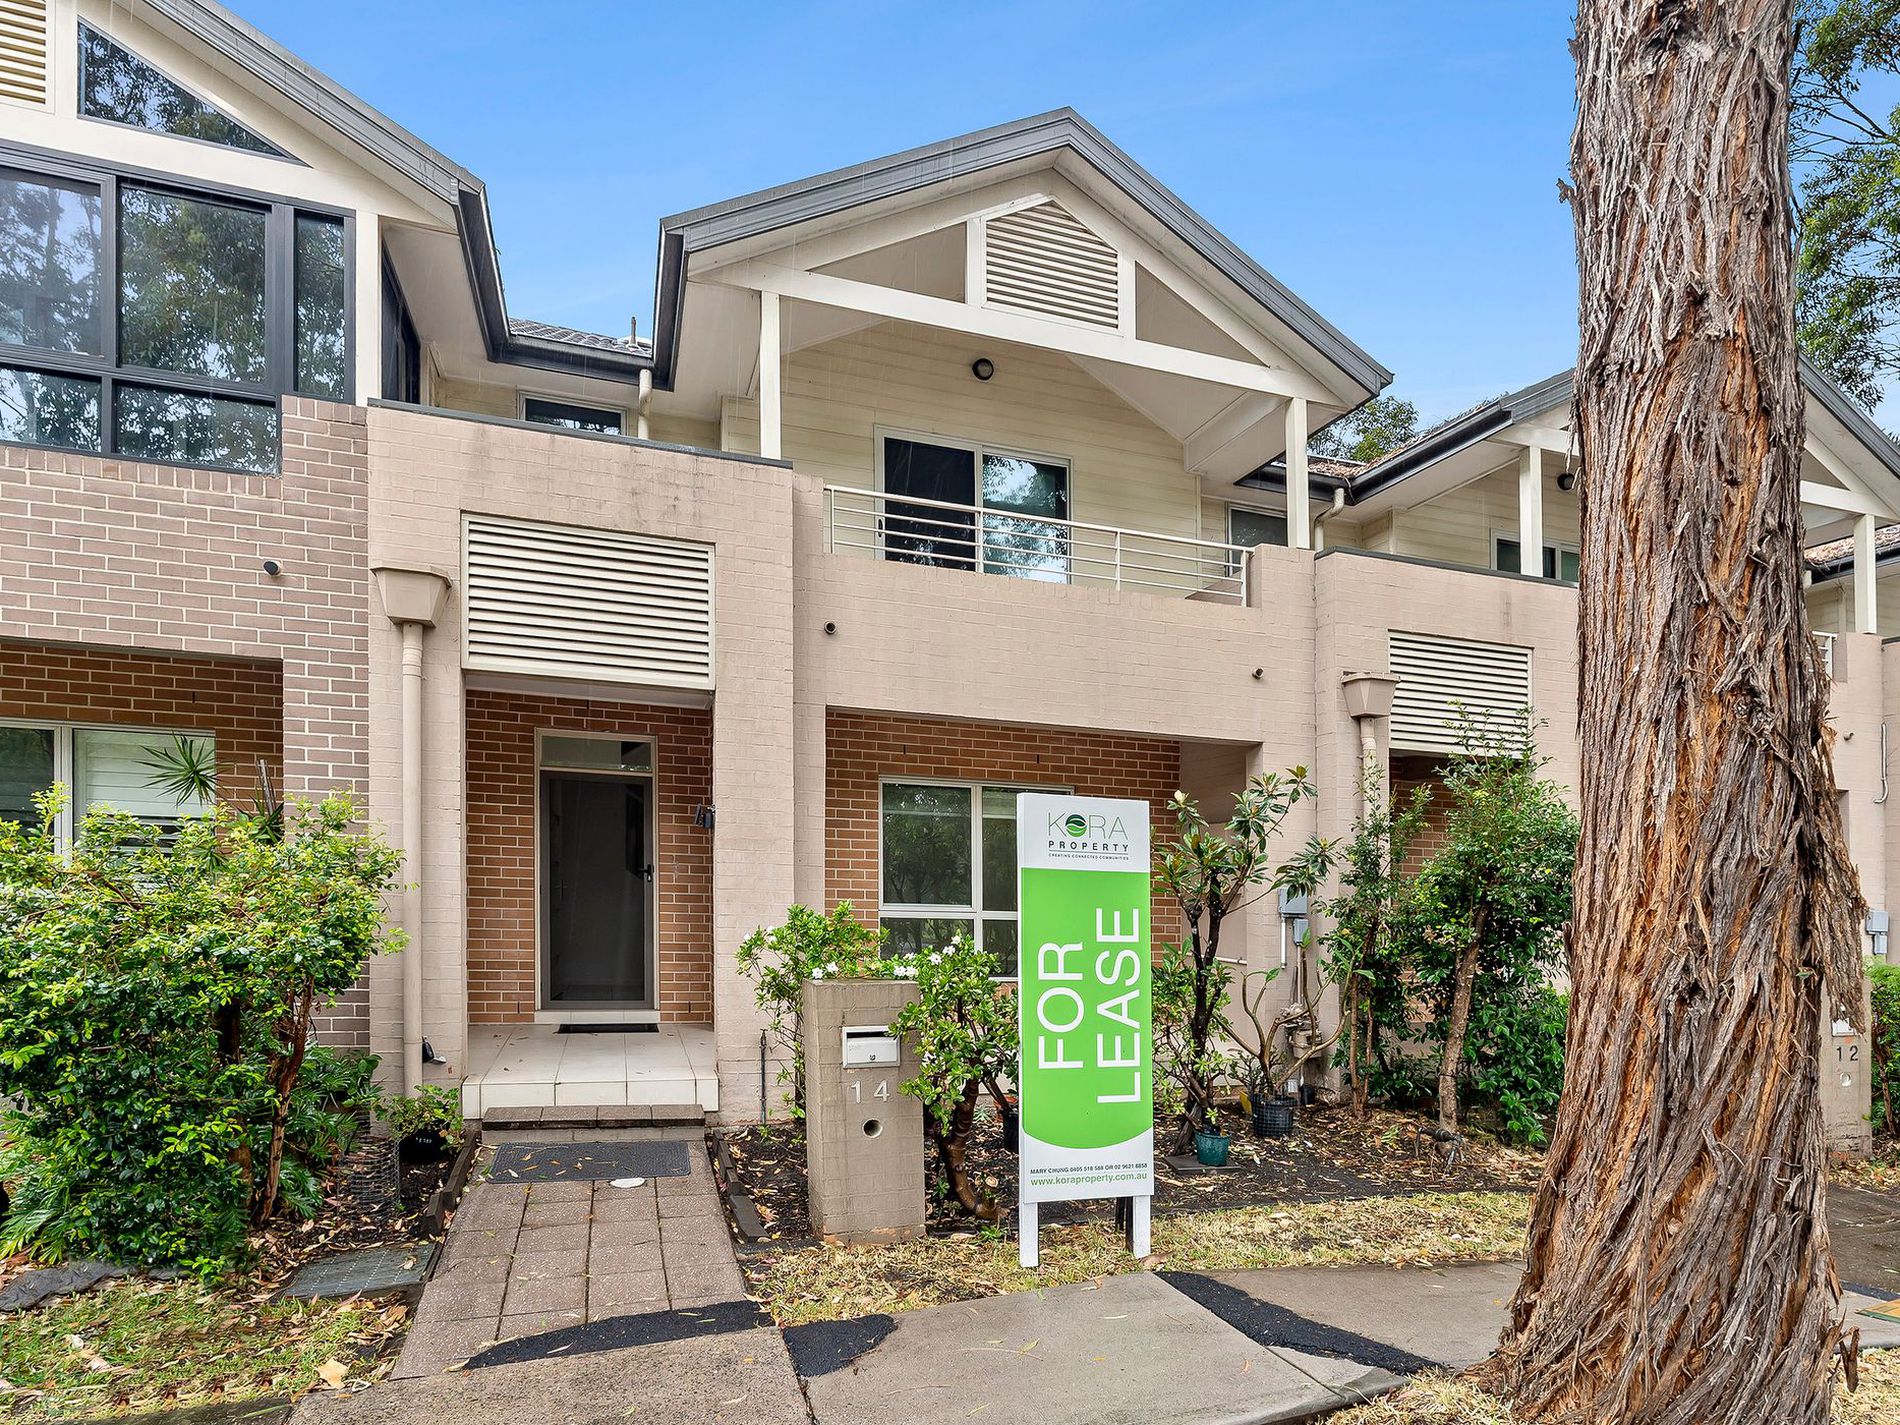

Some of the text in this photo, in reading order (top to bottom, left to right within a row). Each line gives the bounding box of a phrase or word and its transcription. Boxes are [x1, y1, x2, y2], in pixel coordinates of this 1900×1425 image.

[1048, 812, 1129, 840] KORA
[1048, 840, 1129, 852] PROPERTY
[1037, 942, 1085, 1070] FOR
[1095, 908, 1141, 1104] LEASE
[1836, 1046, 1858, 1062] 12
[850, 1080, 890, 1104] 14
[1030, 1173, 1147, 1186] www.koraproperty.com.au
